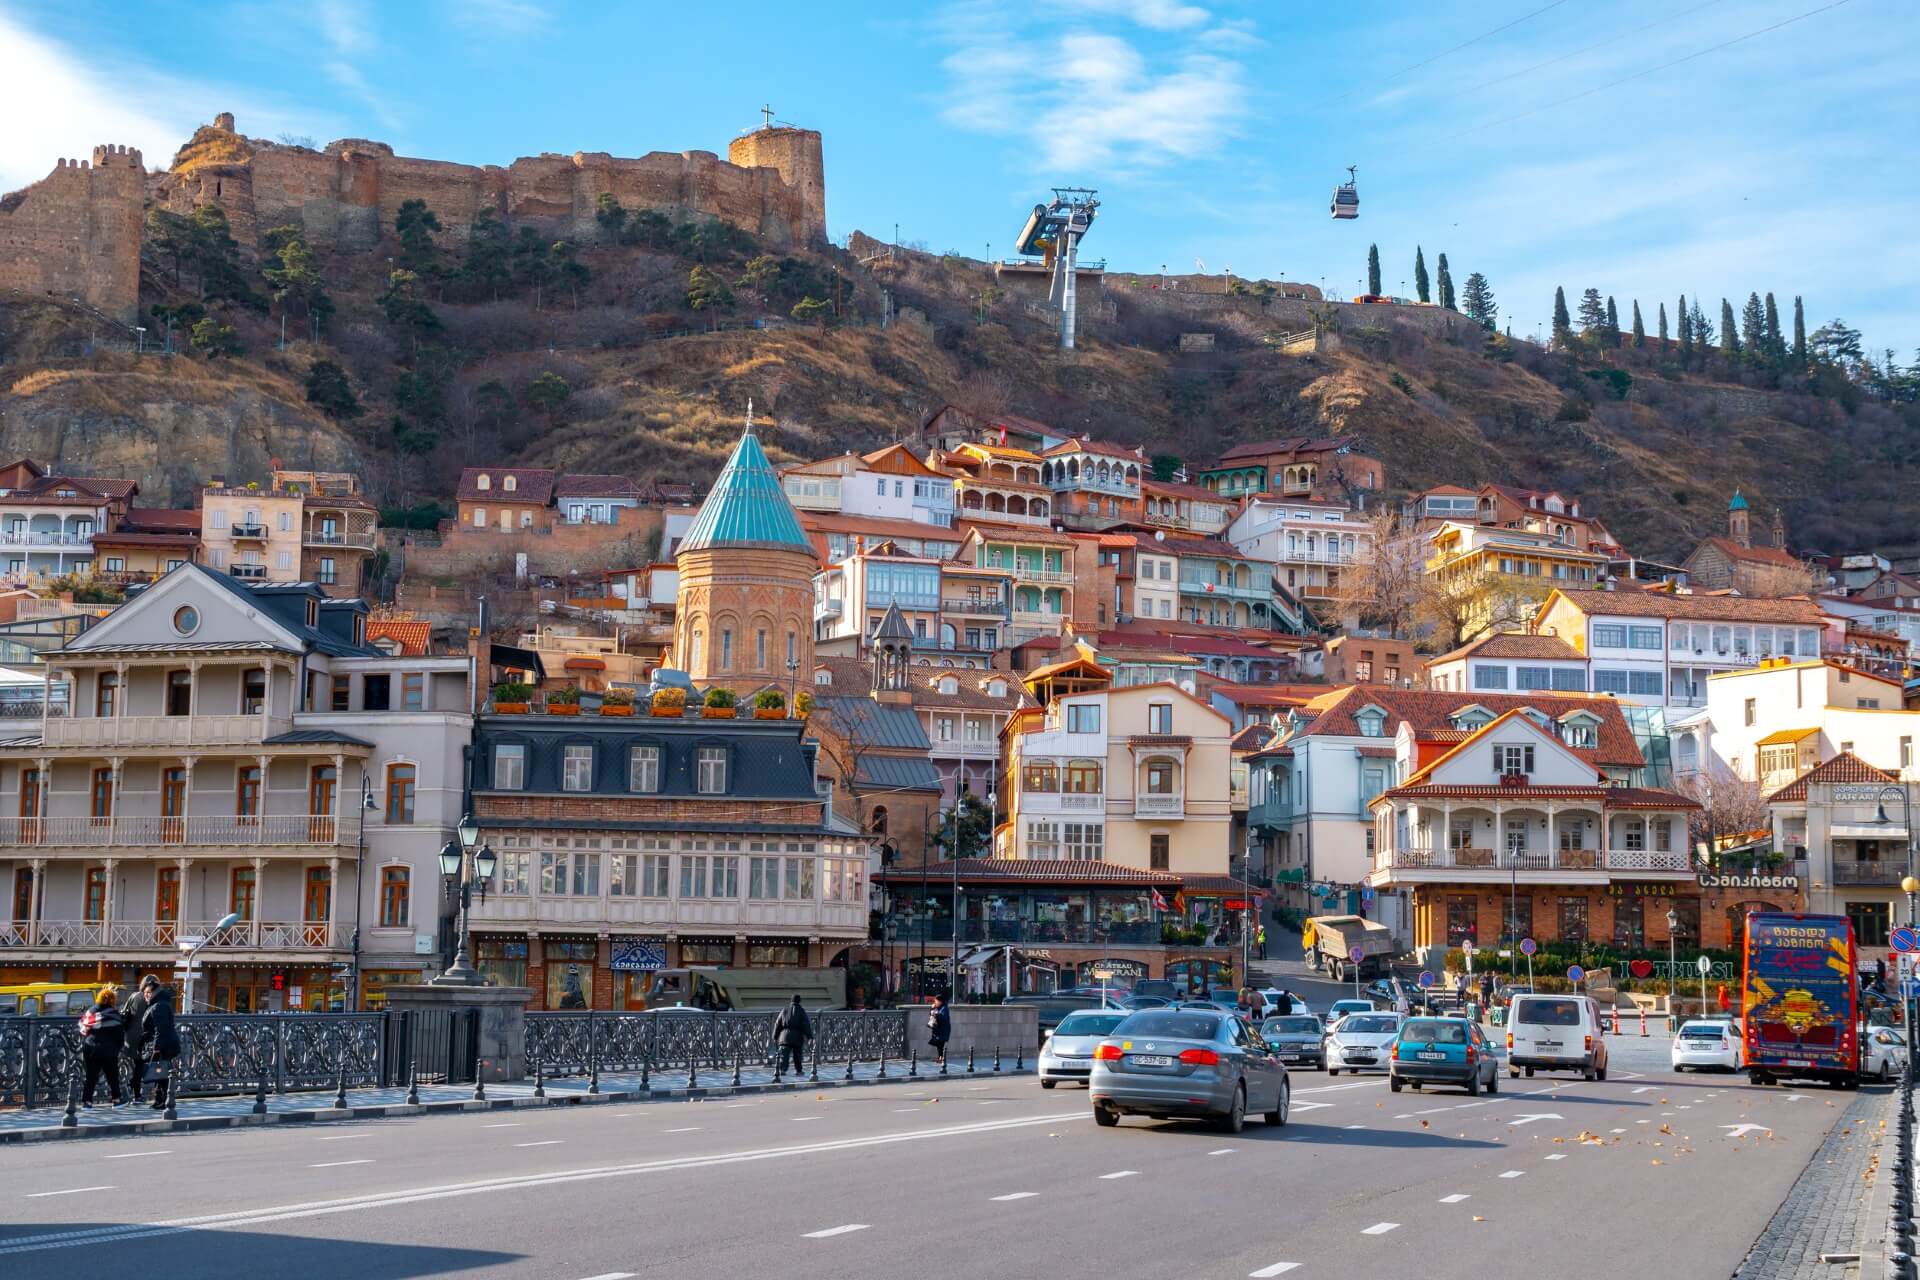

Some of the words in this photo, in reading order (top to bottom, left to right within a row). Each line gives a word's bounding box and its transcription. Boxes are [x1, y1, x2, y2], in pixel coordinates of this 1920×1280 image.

[1835, 793, 1857, 801] CAFE
[1700, 875, 1798, 888] სამიკიტნო
[1773, 927, 1826, 937] ზანადუ
[1775, 938, 1824, 948] კაზინო
[1028, 949, 1052, 959] BAR
[1083, 967, 1143, 977] MRANI
[1619, 960, 1630, 978] I
[1653, 960, 1734, 979] TBILSI
